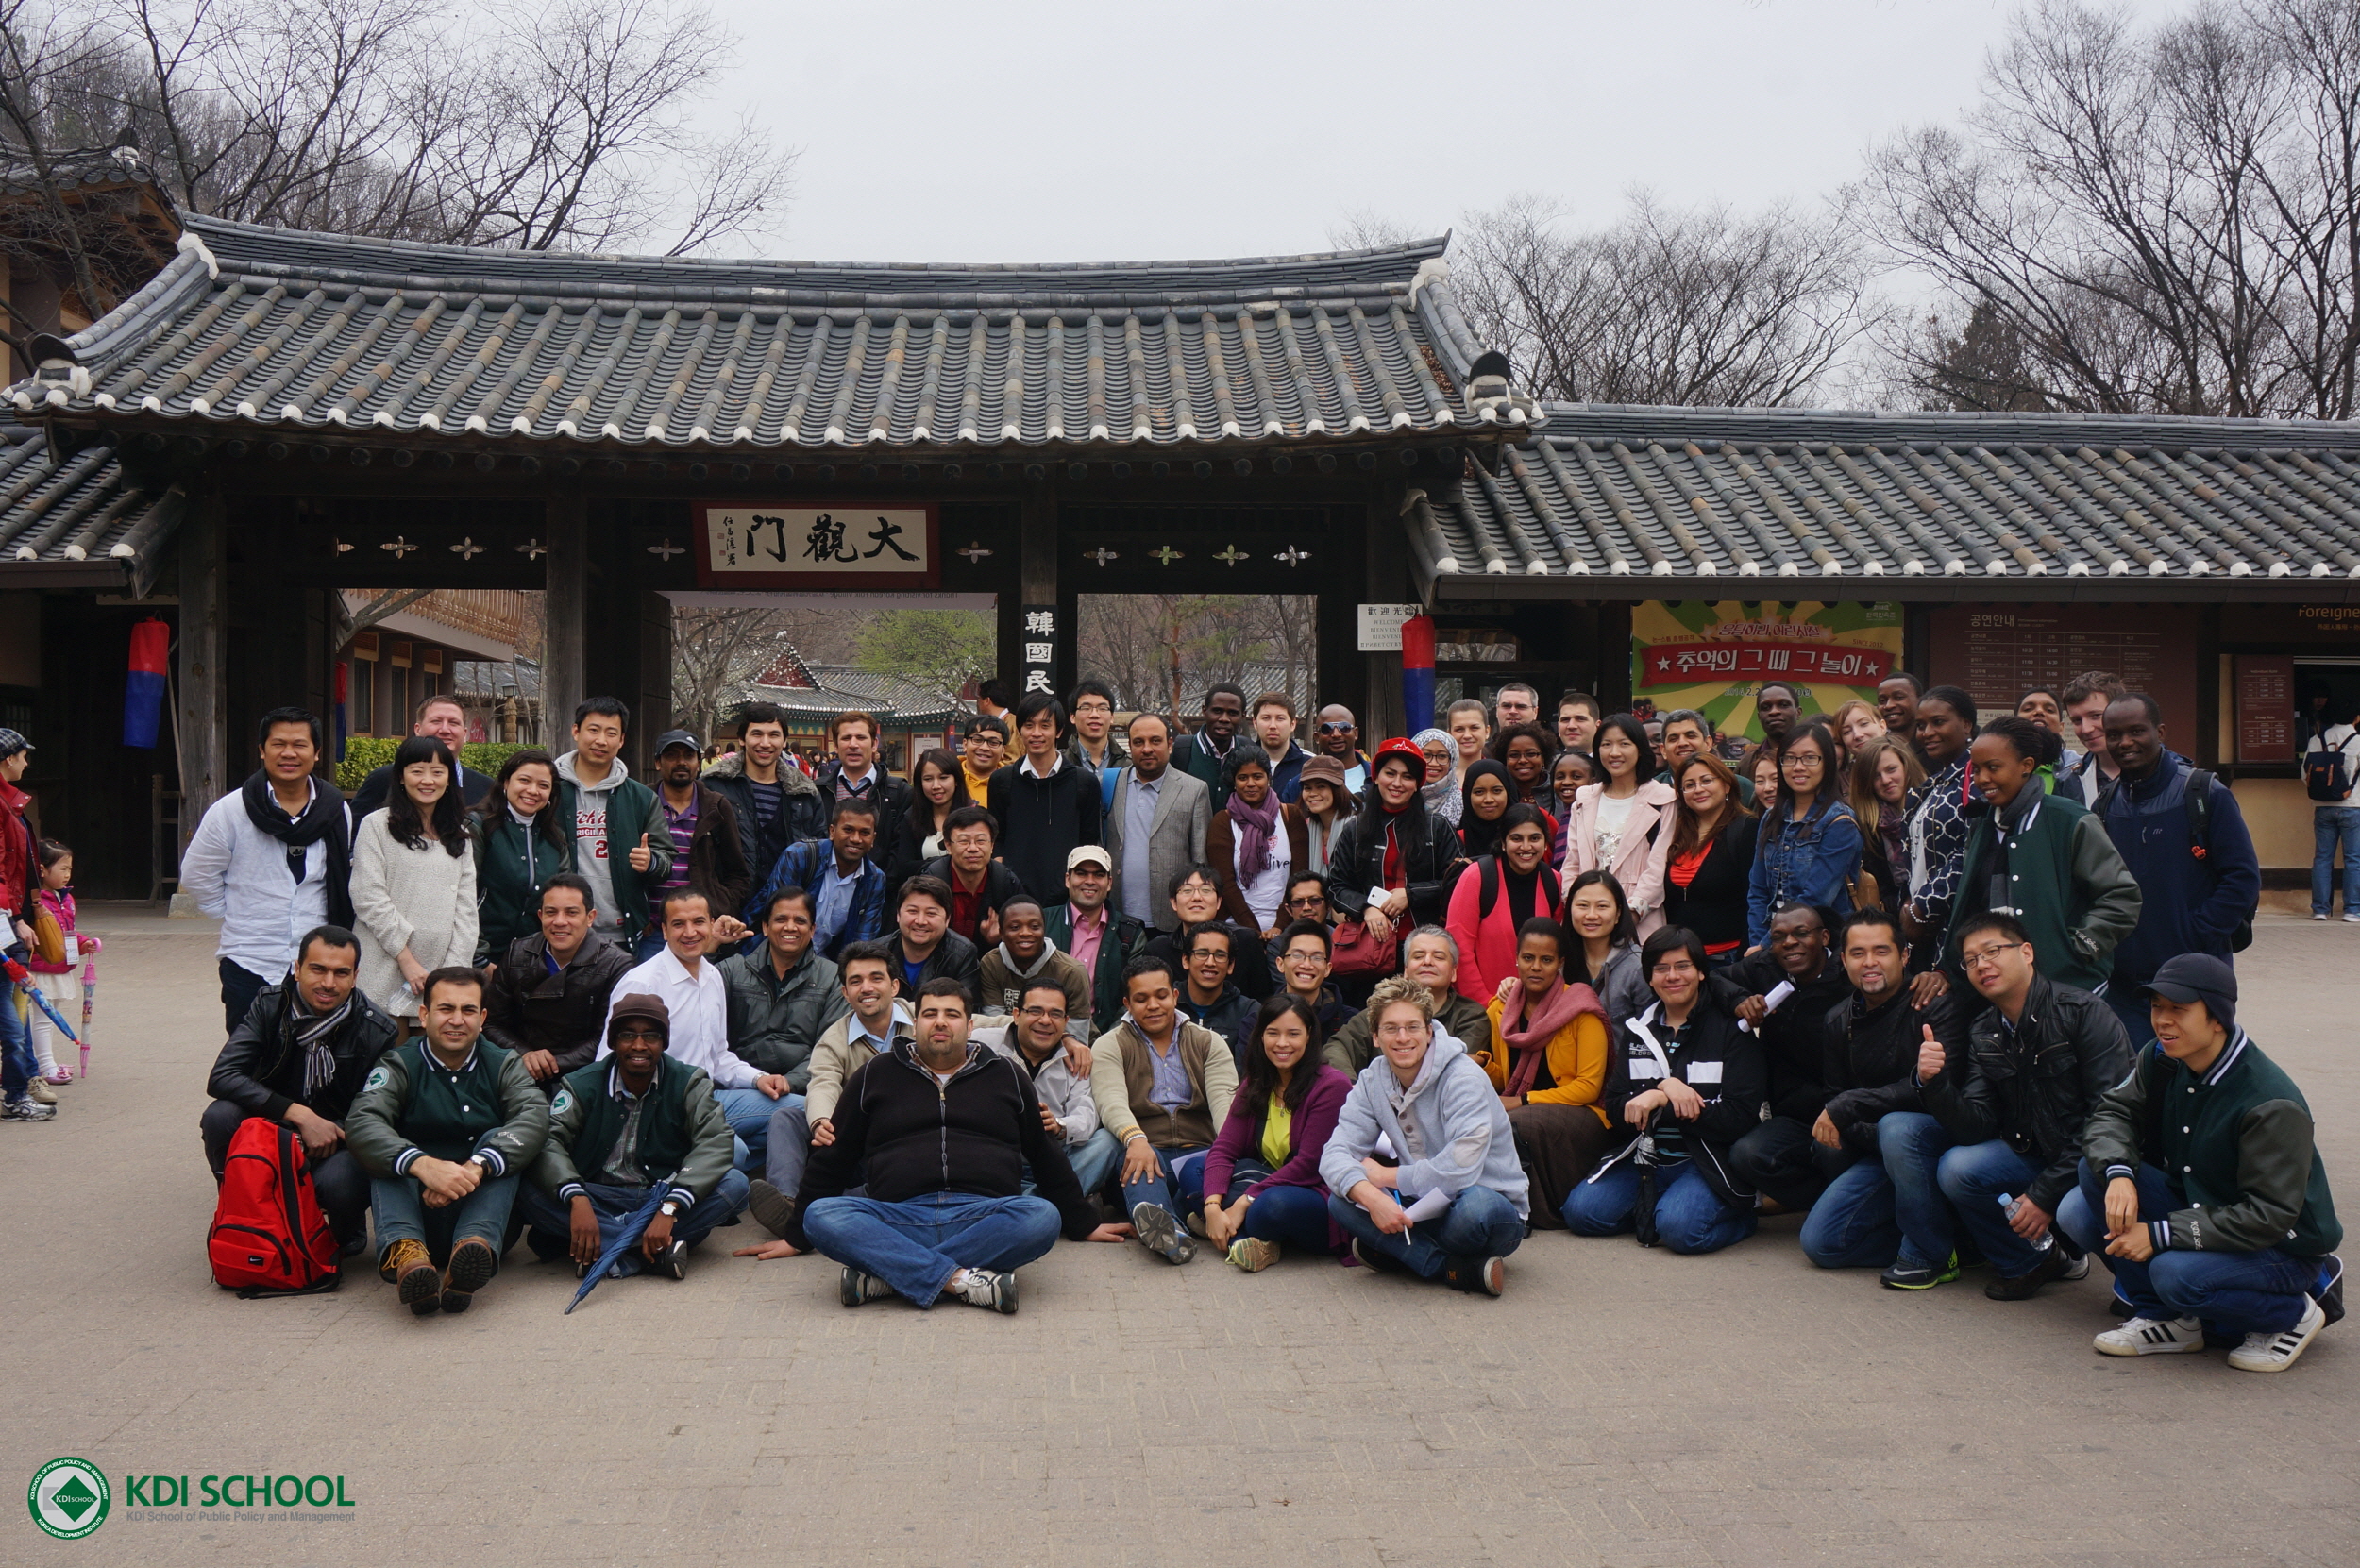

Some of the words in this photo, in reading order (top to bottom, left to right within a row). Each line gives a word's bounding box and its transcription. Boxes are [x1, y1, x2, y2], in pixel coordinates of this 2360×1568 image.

[1970, 615, 2014, 627] 공연안내
[1719, 624, 1770, 635] 응답하라
[1773, 624, 1820, 637] 어린시절
[1025, 611, 1055, 696] 韓國民
[1676, 649, 1738, 673] 추억의
[1741, 649, 1762, 670] 그
[1768, 649, 1790, 671] 때
[1793, 650, 1816, 672] 그
[1820, 652, 1863, 676] 놀이
[576, 828, 607, 836] RIGINA
[595, 838, 609, 859] 2
